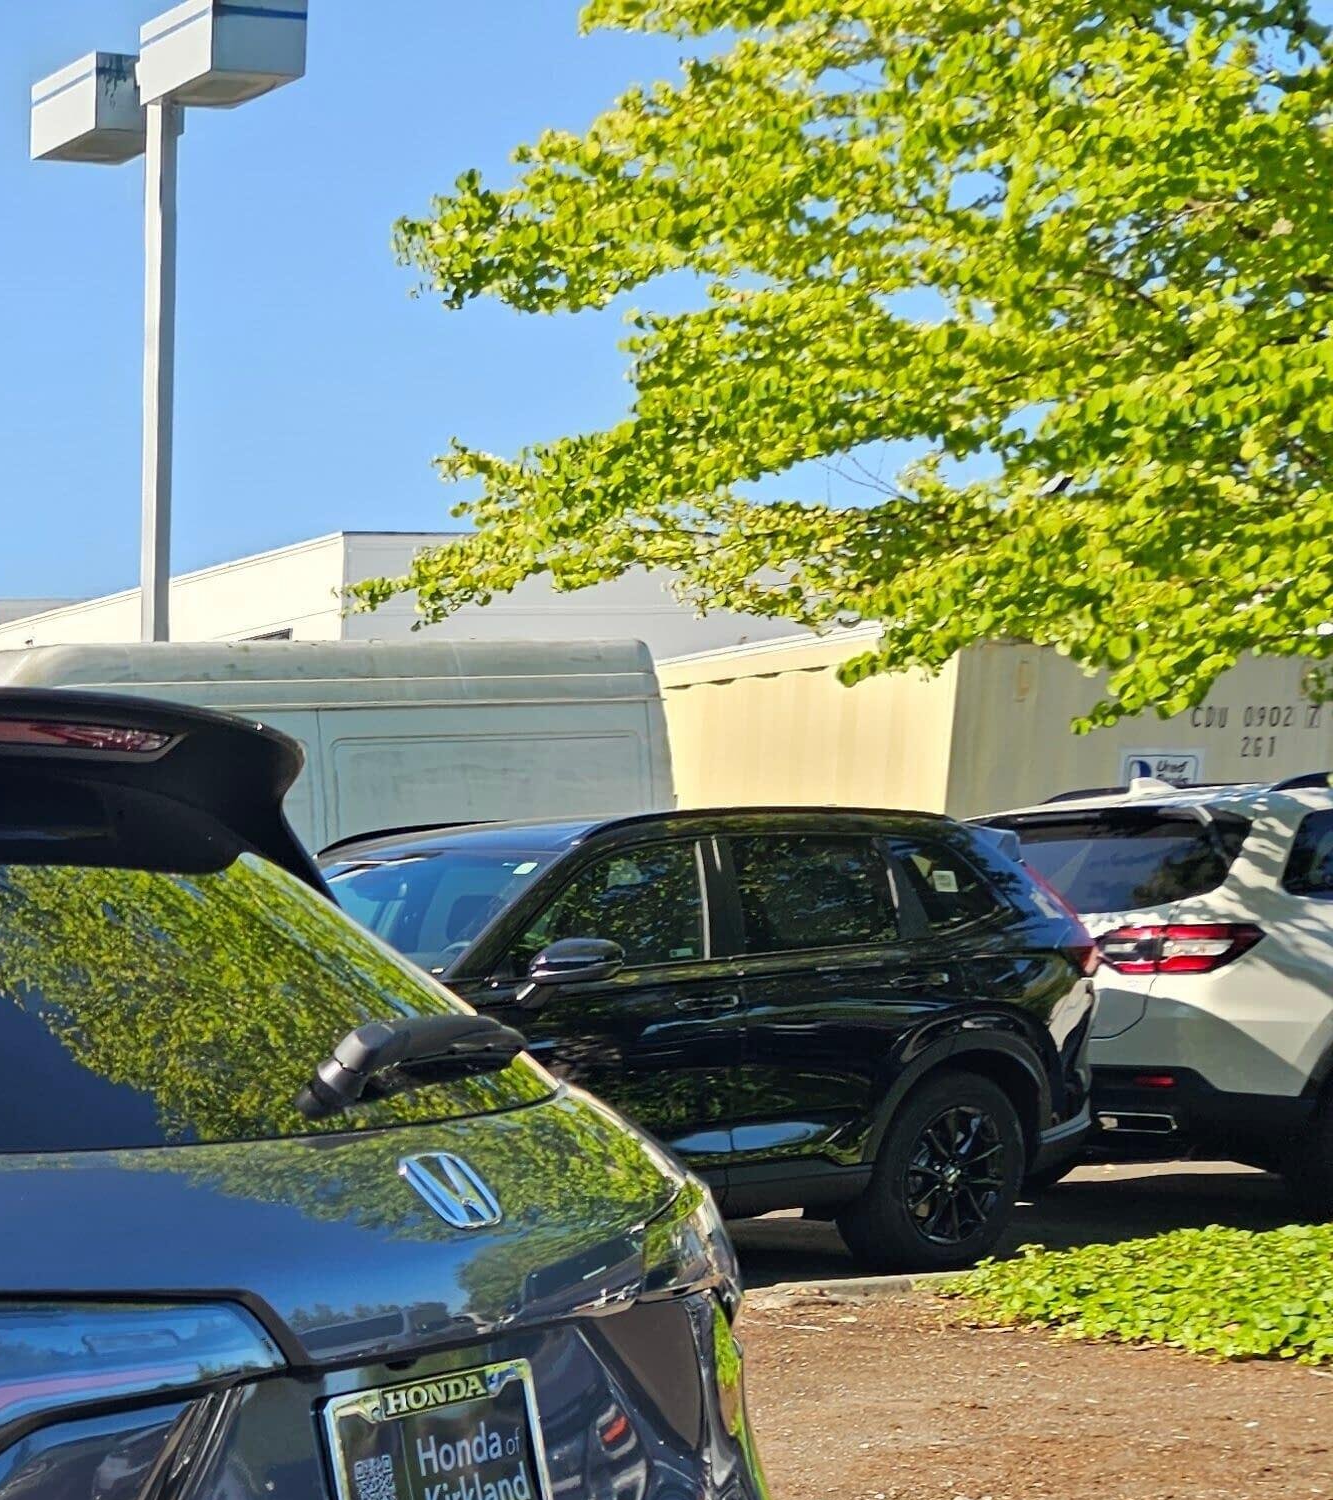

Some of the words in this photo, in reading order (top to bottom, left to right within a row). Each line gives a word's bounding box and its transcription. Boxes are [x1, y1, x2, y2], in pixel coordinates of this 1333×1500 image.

[386, 1374, 486, 1416] HONDA
[416, 1421, 502, 1477] Honda
[505, 1426, 521, 1456] of
